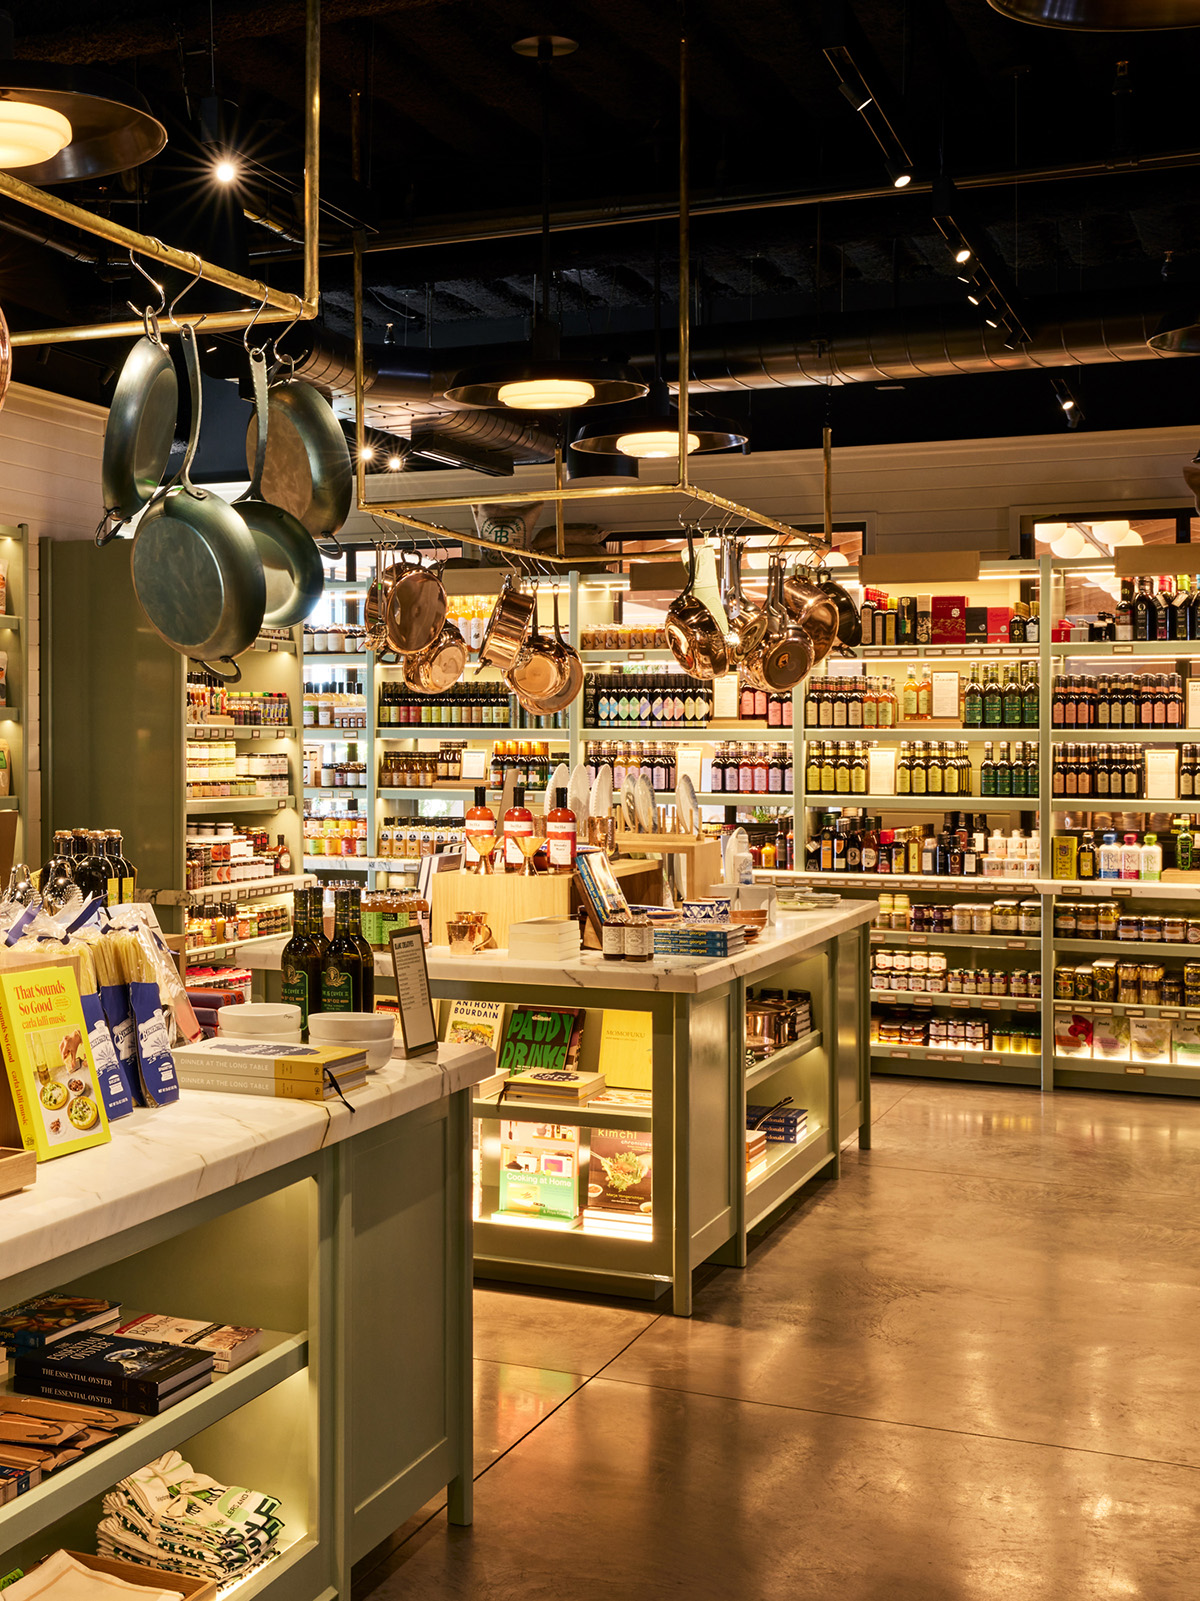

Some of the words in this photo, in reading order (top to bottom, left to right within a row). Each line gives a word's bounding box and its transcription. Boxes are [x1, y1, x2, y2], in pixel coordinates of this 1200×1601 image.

[14, 986, 35, 1000] That
[35, 980, 66, 997] Sounds
[19, 1003, 30, 1016] So
[31, 998, 53, 1014] Good
[454, 1008, 499, 1019] BOURDAIN
[456, 1001, 500, 1010] ANTHONY
[22, 1018, 37, 1029] carla
[37, 1016, 48, 1026] lalli
[49, 1013, 66, 1024] music
[506, 1011, 574, 1042] PADDY
[606, 1030, 646, 1038] MOMOFUKU
[3, 1034, 9, 1043] So
[6, 1044, 15, 1063] Good
[500, 1041, 566, 1076] DRINKS
[11, 1071, 20, 1087] carla
[19, 1104, 28, 1125] music
[507, 1173, 538, 1184] Cooking
[540, 1176, 548, 1184] at
[549, 1177, 571, 1187] Home
[47, 1337, 106, 1360] ESSENTIAL
[70, 1341, 115, 1360] OYSTER
[42, 1367, 54, 1377] THE
[55, 1369, 88, 1382] ESSENTIAL
[88, 1375, 113, 1387] OYSTER
[41, 1385, 54, 1394] THE
[54, 1387, 87, 1400] ESSENTIAL
[88, 1393, 113, 1405] OYSTER
